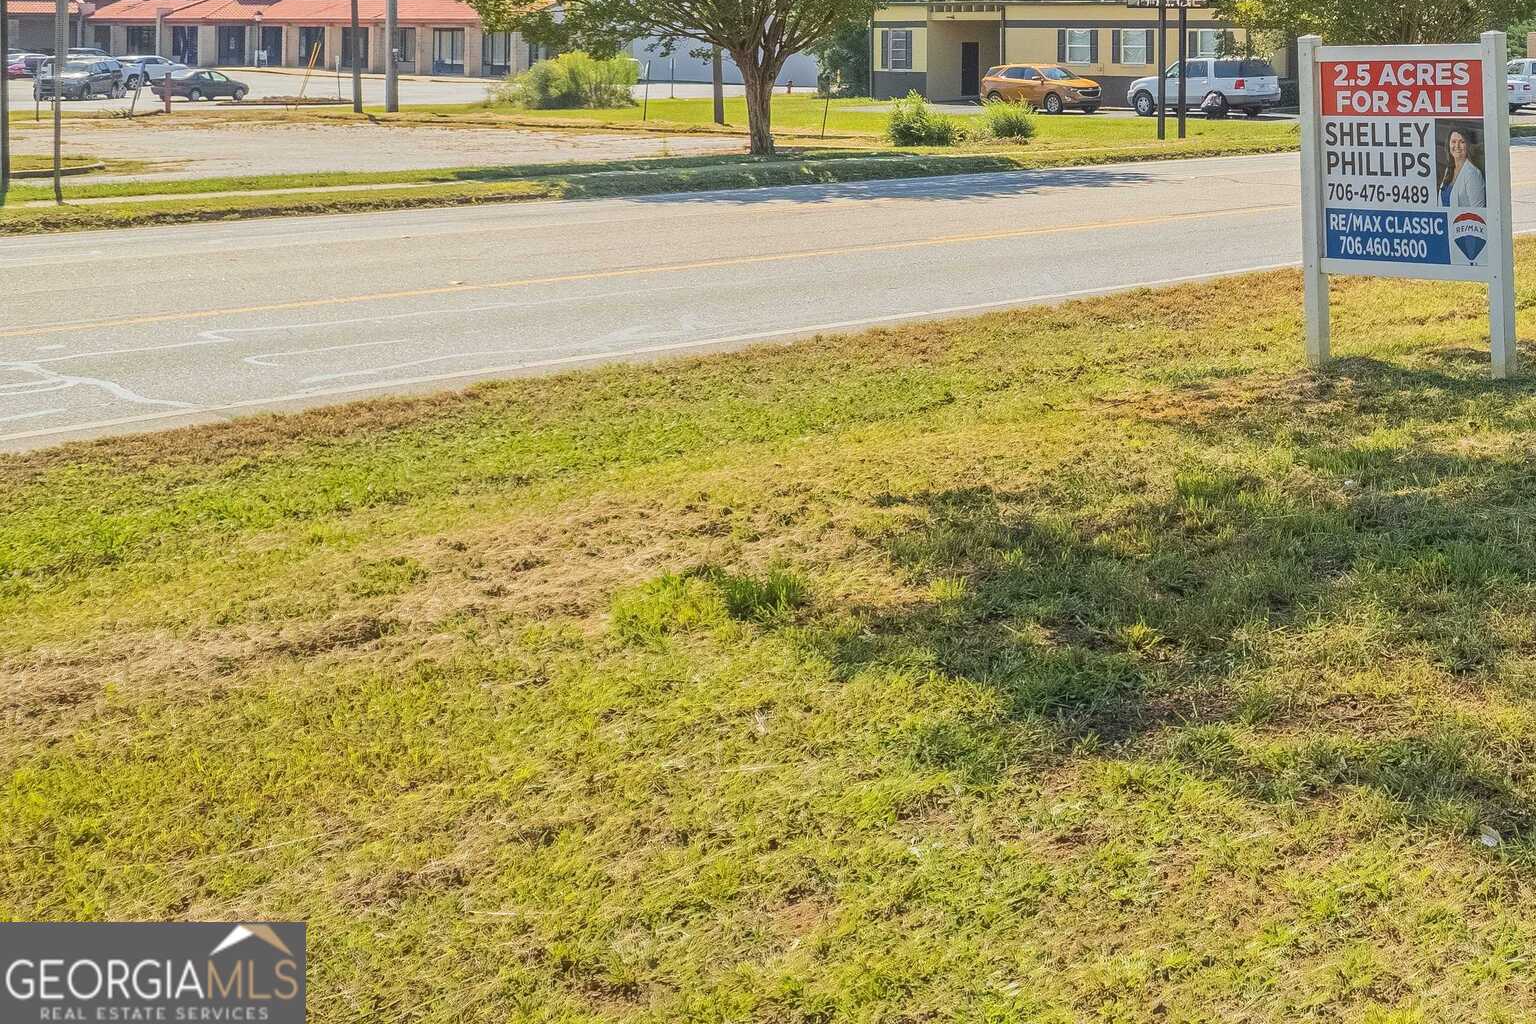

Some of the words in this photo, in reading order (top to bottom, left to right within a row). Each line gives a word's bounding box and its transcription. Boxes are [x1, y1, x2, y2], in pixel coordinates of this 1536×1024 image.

[1333, 64, 1371, 86] 2.5
[1378, 62, 1470, 86] ACRES
[1336, 90, 1389, 113] FOR
[1397, 90, 1469, 113] SALE
[1325, 122, 1430, 147] SHELLEY
[1327, 151, 1431, 178] PHILLIPS
[1328, 183, 1429, 204] 706-476-9489
[1330, 213, 1382, 233] RE/MAX
[1385, 216, 1444, 235] CLASSIC
[1456, 225, 1484, 233] RE/MAX
[1340, 236, 1428, 258] 706.460.5600
